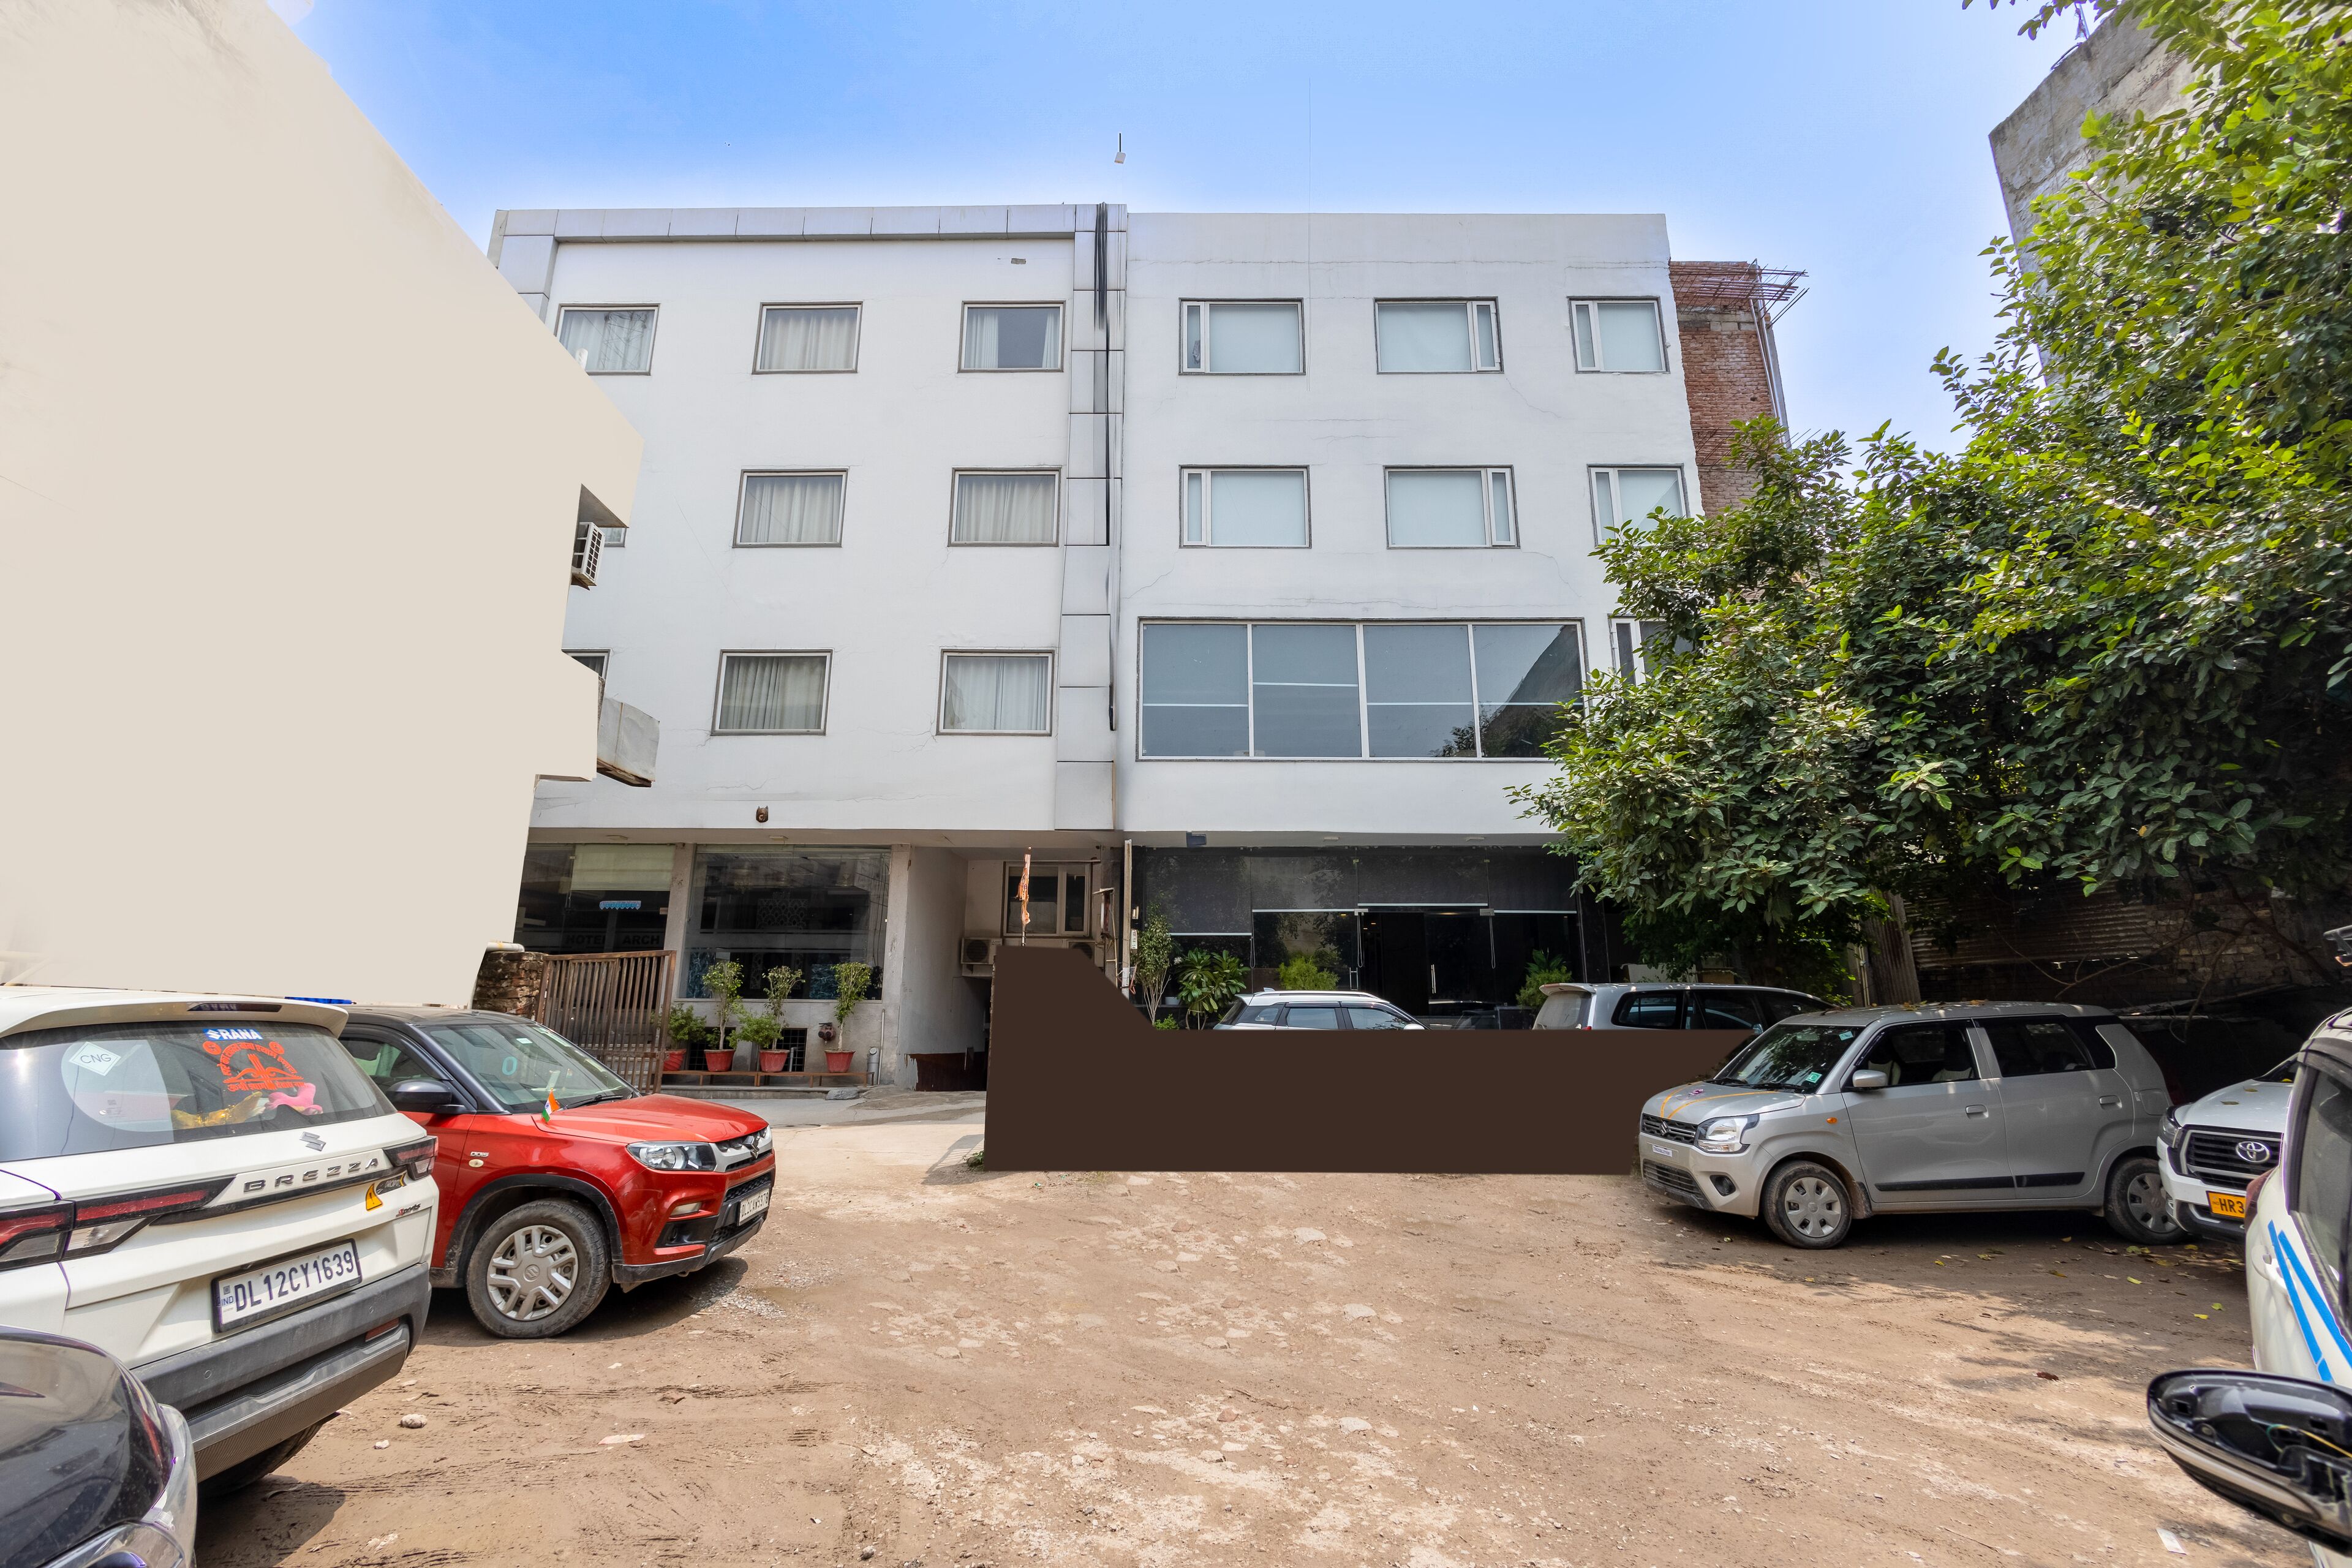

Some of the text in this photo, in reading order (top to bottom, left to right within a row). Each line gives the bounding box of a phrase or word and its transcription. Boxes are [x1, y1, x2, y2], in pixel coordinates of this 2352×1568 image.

[622, 935, 660, 944] ARCH
[219, 1029, 263, 1039] RANA
[80, 1054, 111, 1063] CNG
[244, 1158, 379, 1193] BREZZA
[221, 1251, 354, 1312] IND DL12CY1639
